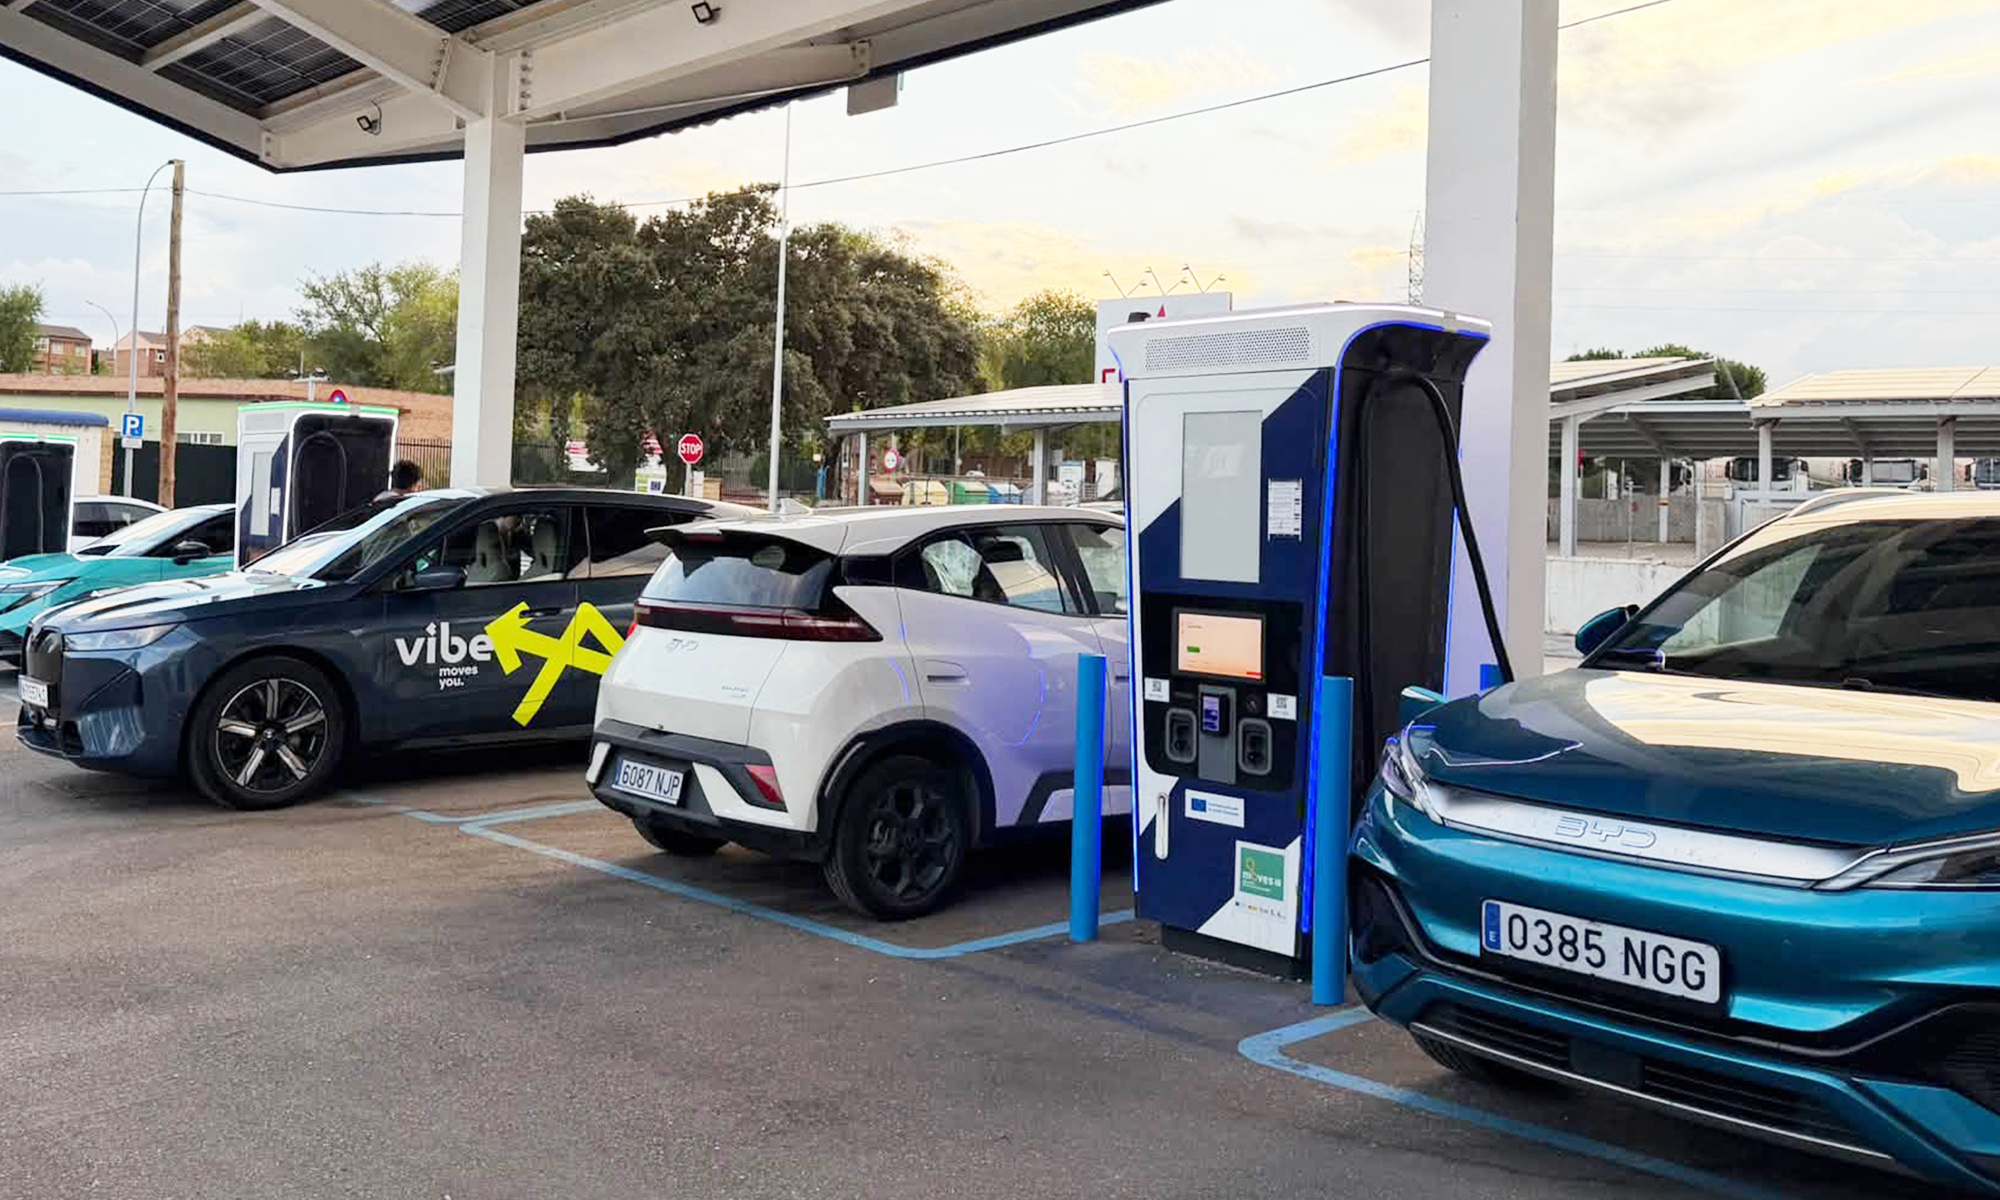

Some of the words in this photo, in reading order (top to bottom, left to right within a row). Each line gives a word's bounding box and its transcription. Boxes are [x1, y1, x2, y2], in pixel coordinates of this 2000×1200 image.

[126, 416, 140, 437] P
[681, 443, 702, 455] STOP
[394, 621, 495, 666] vibe
[439, 666, 479, 677] moves
[439, 678, 465, 690] you.
[622, 764, 654, 790] 6087
[655, 772, 680, 796] NJP
[1555, 816, 1657, 849] BYD
[1508, 913, 1606, 969] 0385
[1623, 937, 1706, 991] NGG
